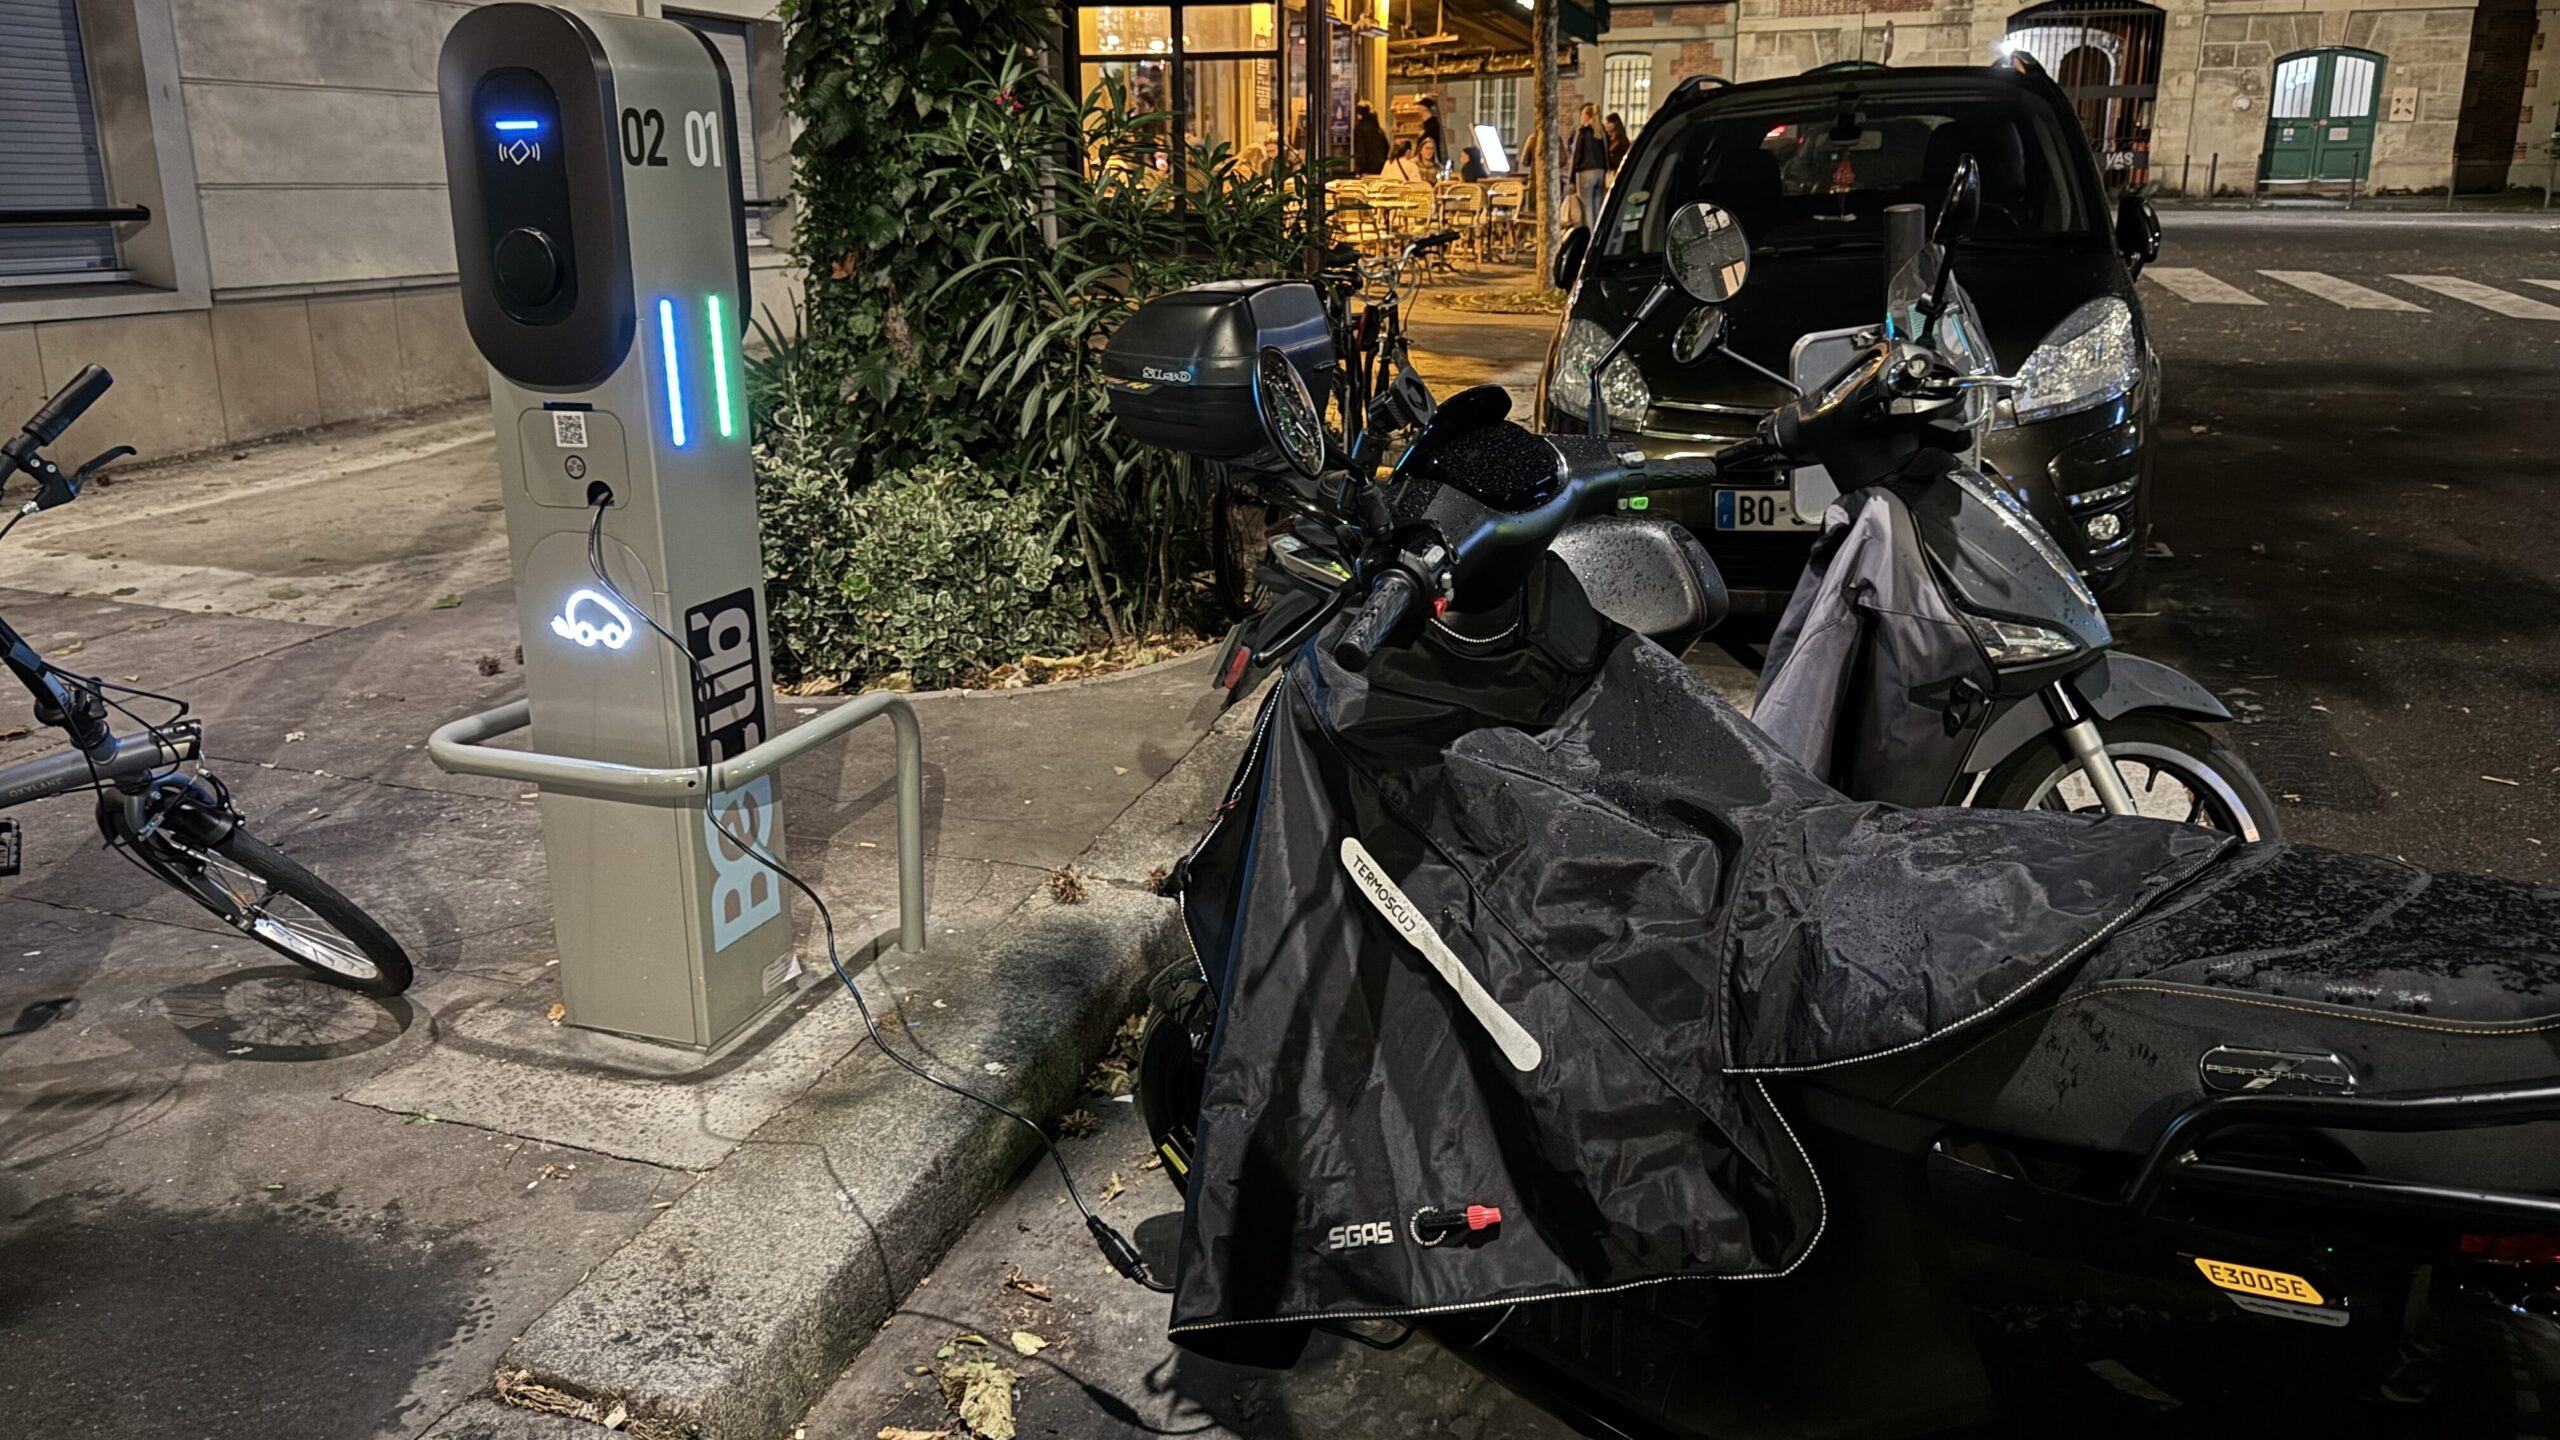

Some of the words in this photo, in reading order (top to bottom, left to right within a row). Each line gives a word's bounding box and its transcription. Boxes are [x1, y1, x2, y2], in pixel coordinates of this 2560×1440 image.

[621, 107, 668, 167] 02
[684, 110, 721, 168] 01
[1739, 496, 1806, 525] BQ-
[2206, 1063, 2345, 1086] PERFORMANCE
[2209, 1264, 2308, 1298] E300SE
